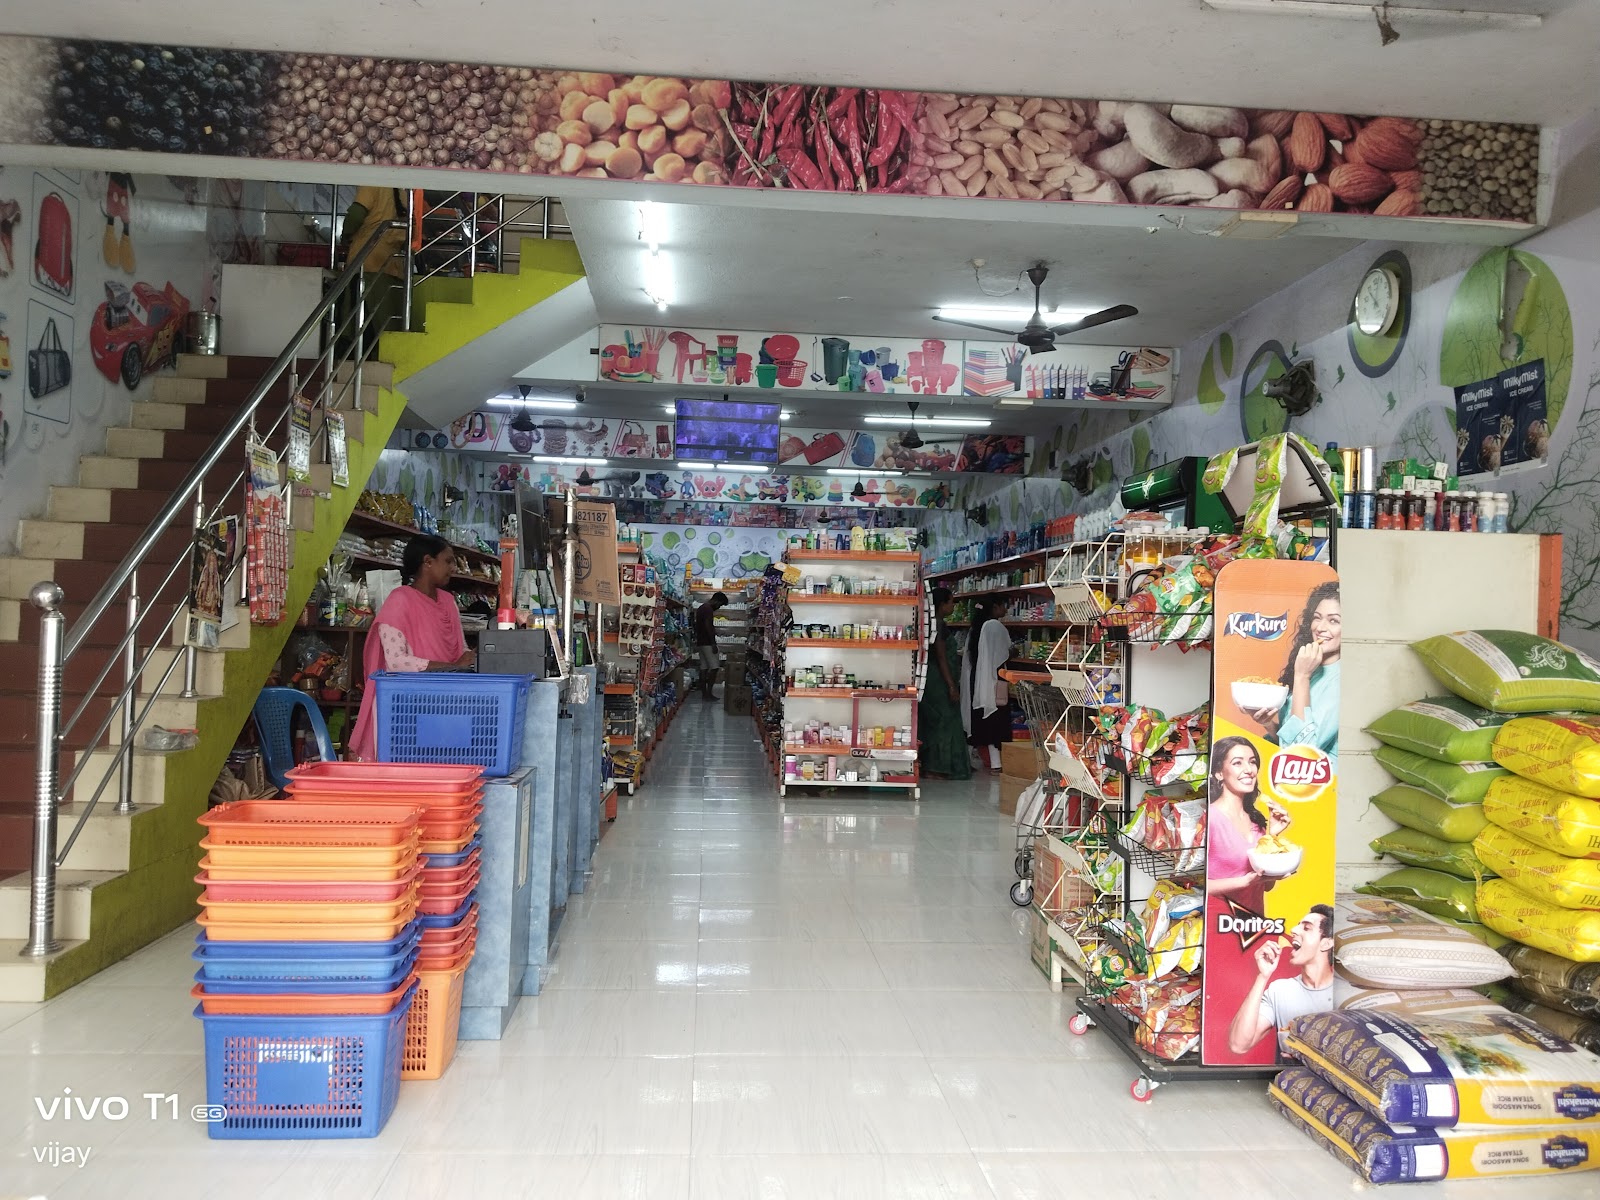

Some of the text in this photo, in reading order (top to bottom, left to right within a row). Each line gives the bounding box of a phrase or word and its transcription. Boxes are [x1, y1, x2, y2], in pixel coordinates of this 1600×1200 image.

[1509, 385, 1534, 397] ICE CREAM
[1474, 402, 1489, 410] CREAM
[576, 510, 607, 522] 821187
[1228, 612, 1287, 639] Kurkure
[1218, 914, 1284, 934] Doritos
[1545, 1148, 1586, 1159] Meenakshi
